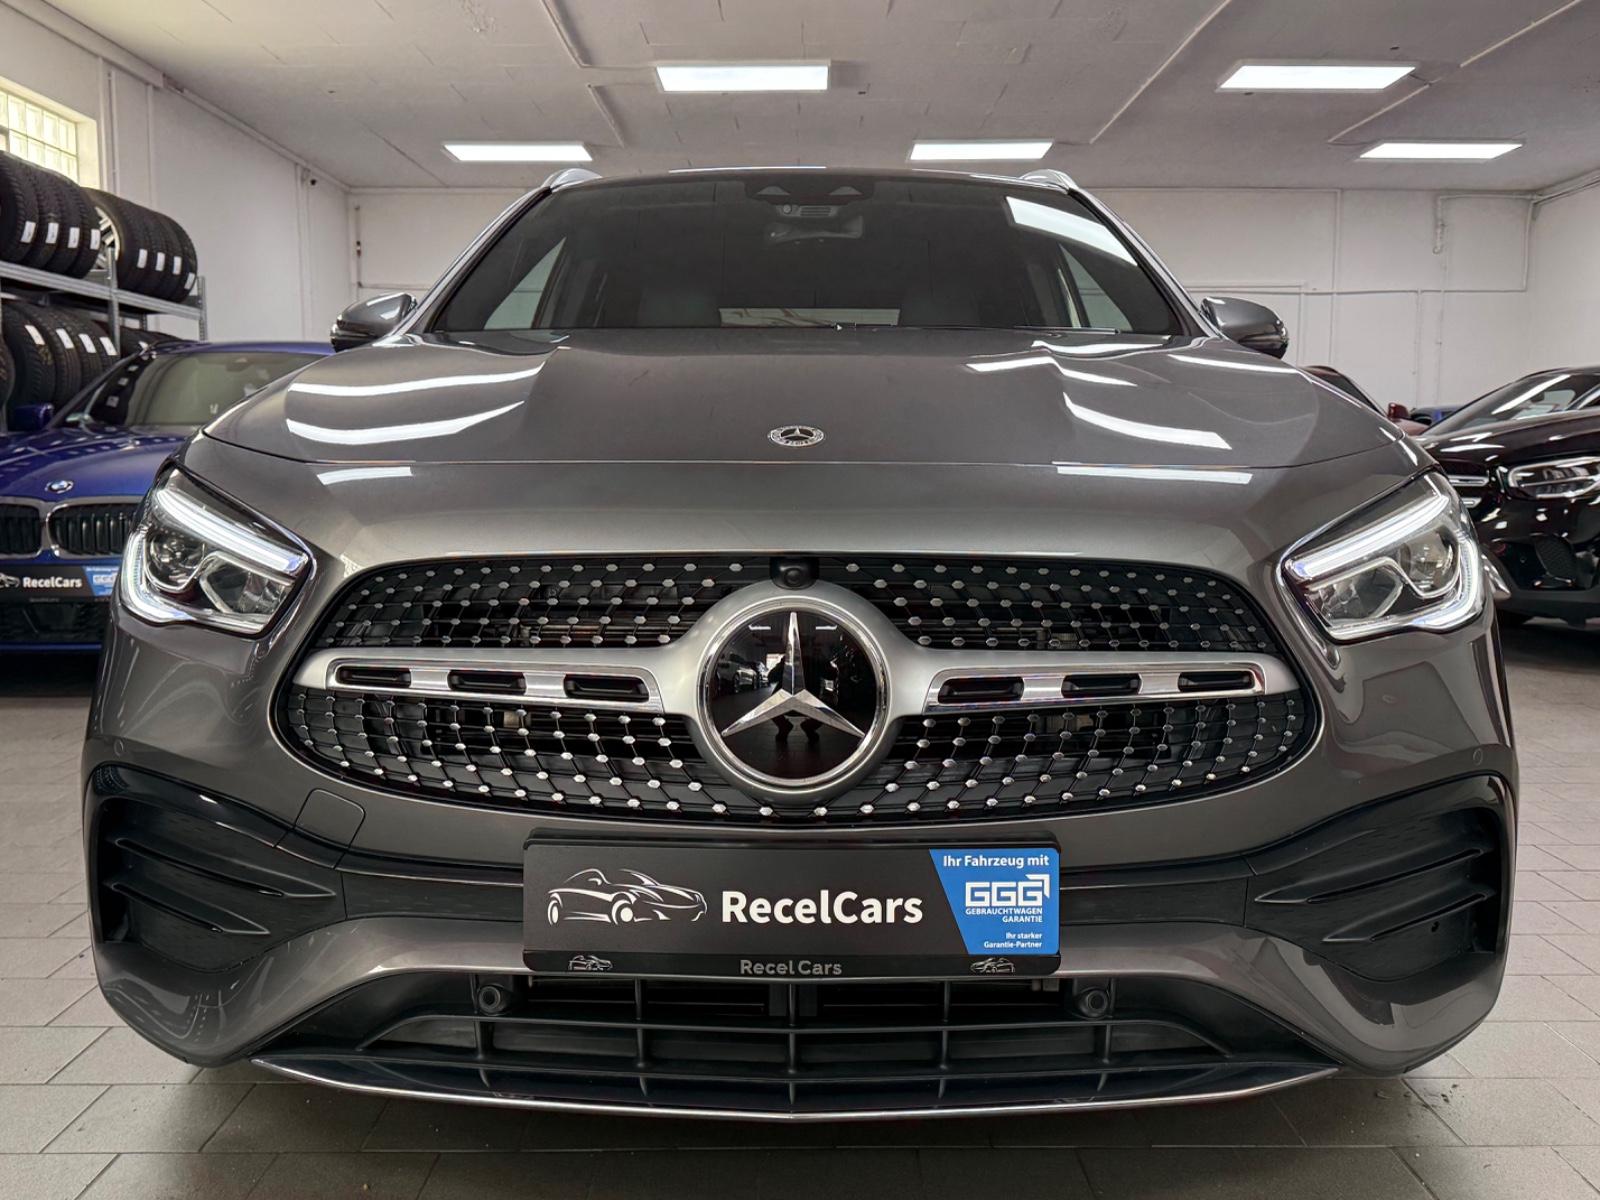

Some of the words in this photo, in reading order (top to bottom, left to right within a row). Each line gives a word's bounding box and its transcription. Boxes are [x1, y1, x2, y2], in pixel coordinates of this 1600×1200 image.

[22, 576, 83, 588] RecelCars
[943, 855, 962, 867] Ihr
[964, 855, 1024, 869] Fahrzeug
[1027, 854, 1050, 866] mit
[965, 881, 1043, 907] GGG
[721, 889, 923, 924] RecelCars
[965, 907, 1043, 915] GEBRAUCHTWAGEN
[1002, 915, 1043, 923] GARANTIE
[983, 941, 1043, 949] Garantie-Partner
[740, 959, 795, 975] Recel
[797, 960, 843, 975] Cars
